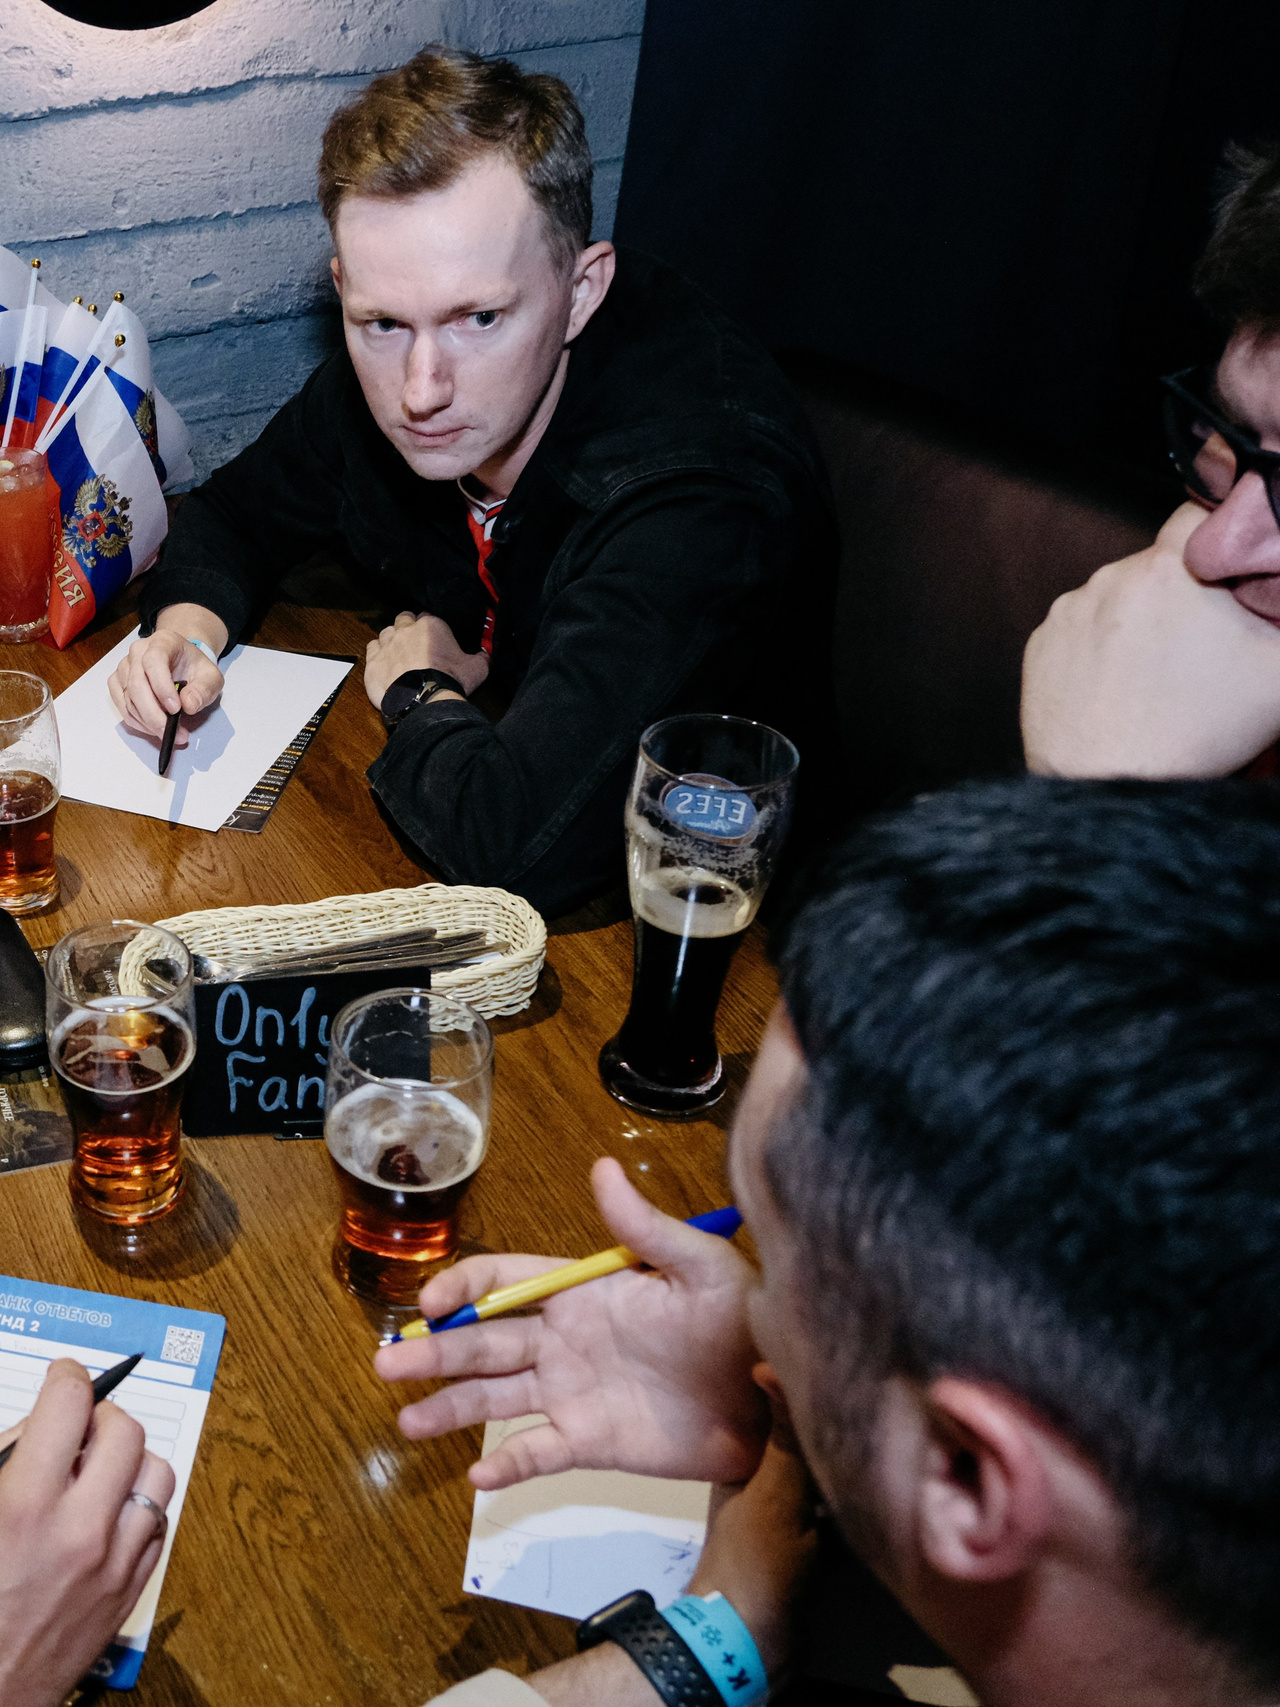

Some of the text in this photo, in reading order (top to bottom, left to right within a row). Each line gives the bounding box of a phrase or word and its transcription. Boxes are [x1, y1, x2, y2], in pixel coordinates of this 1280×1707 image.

[215, 983, 360, 1066] Only
[226, 1051, 331, 1114] Fan
[29, 1319, 40, 1332] 2
[34, 1301, 113, 1327] ОТВЕТОВ
